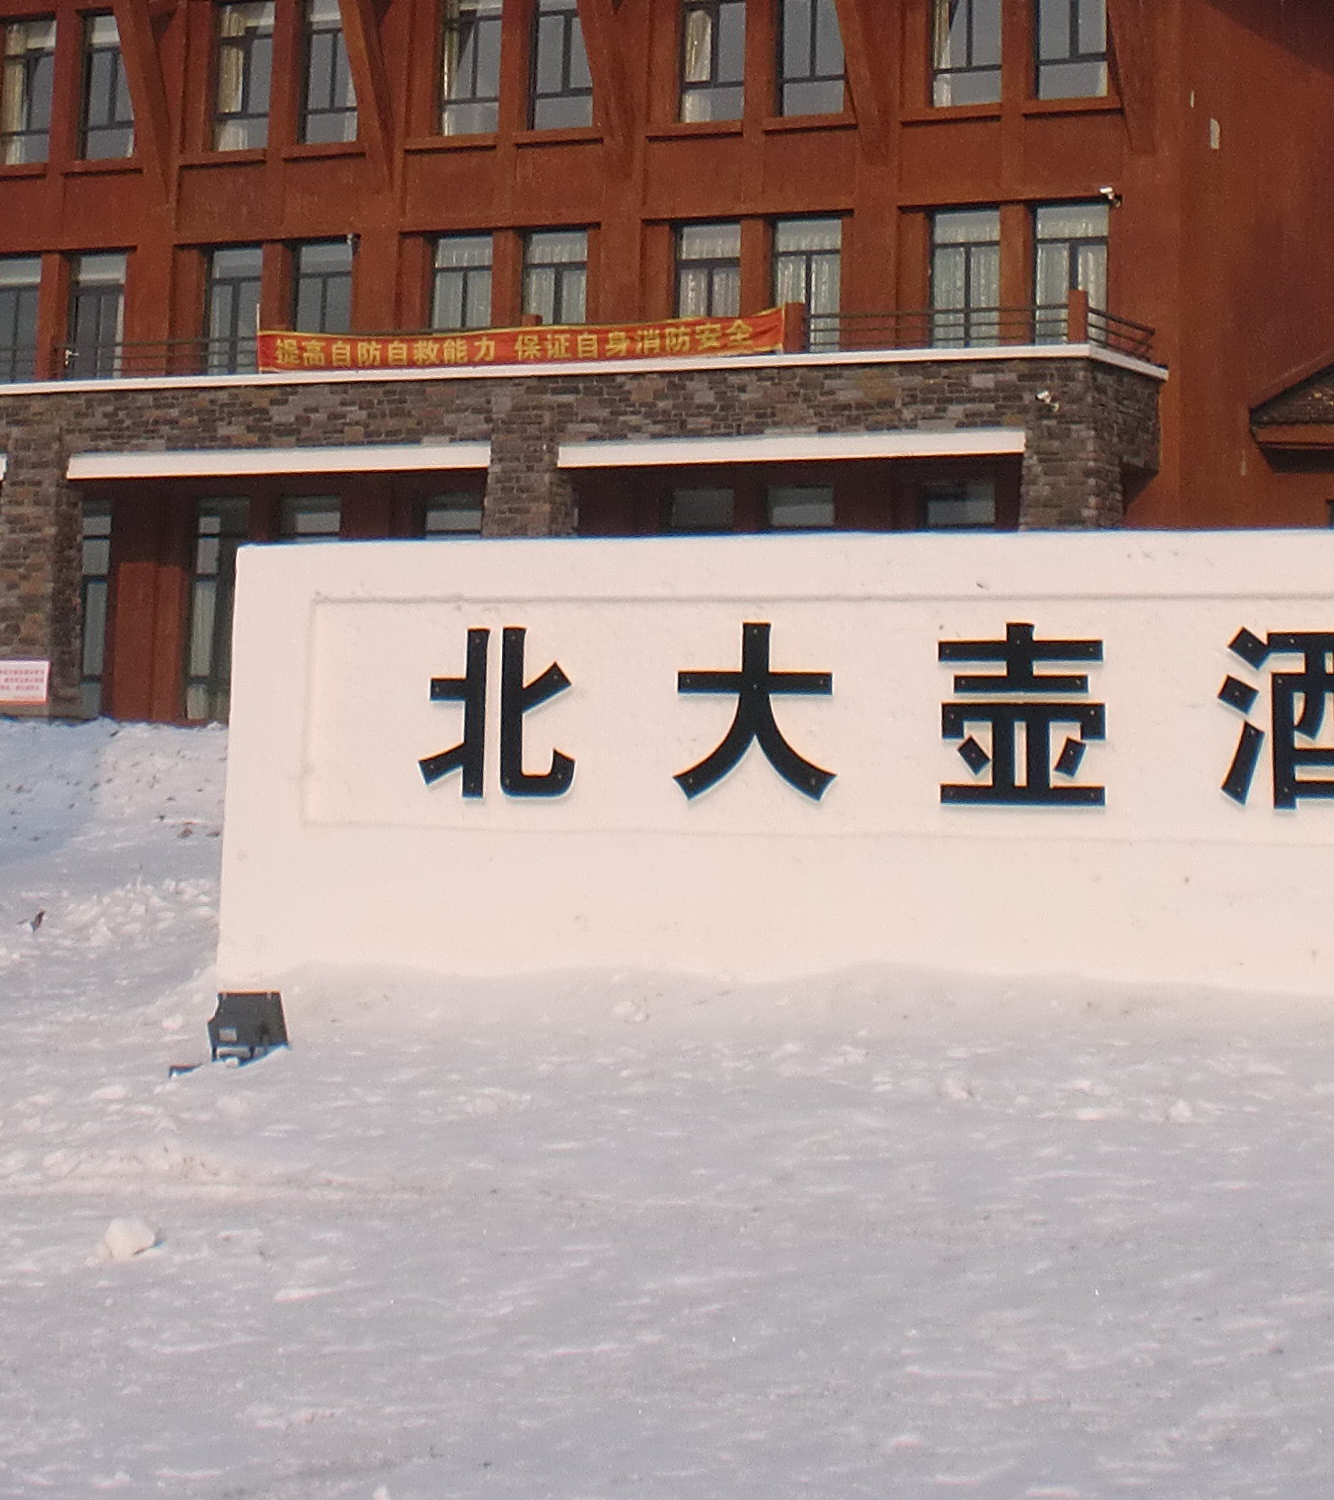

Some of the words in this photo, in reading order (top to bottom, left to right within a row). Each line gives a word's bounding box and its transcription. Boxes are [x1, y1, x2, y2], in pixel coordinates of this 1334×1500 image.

[275, 336, 496, 367] 提高自防自救能力
[514, 319, 753, 360] 保证自身消防安全
